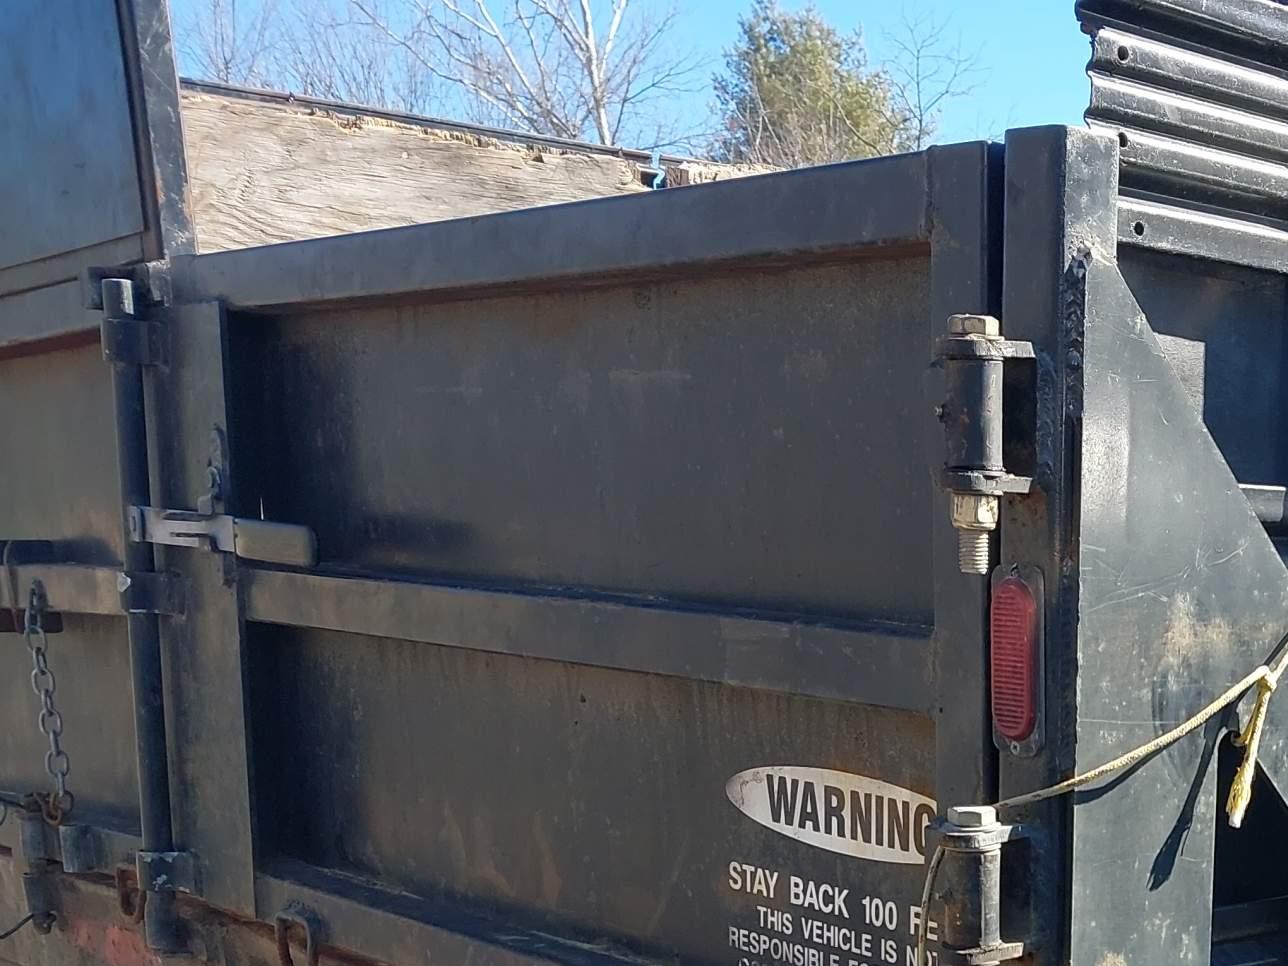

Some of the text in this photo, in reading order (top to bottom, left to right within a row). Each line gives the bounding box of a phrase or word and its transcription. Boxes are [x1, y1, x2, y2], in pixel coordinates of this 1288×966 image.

[728, 861, 779, 898] STAY
[790, 875, 850, 919] BACK
[862, 895, 898, 931] 100
[757, 905, 793, 934] THIS
[801, 917, 872, 957] VEHICLE
[881, 938, 898, 964] IS
